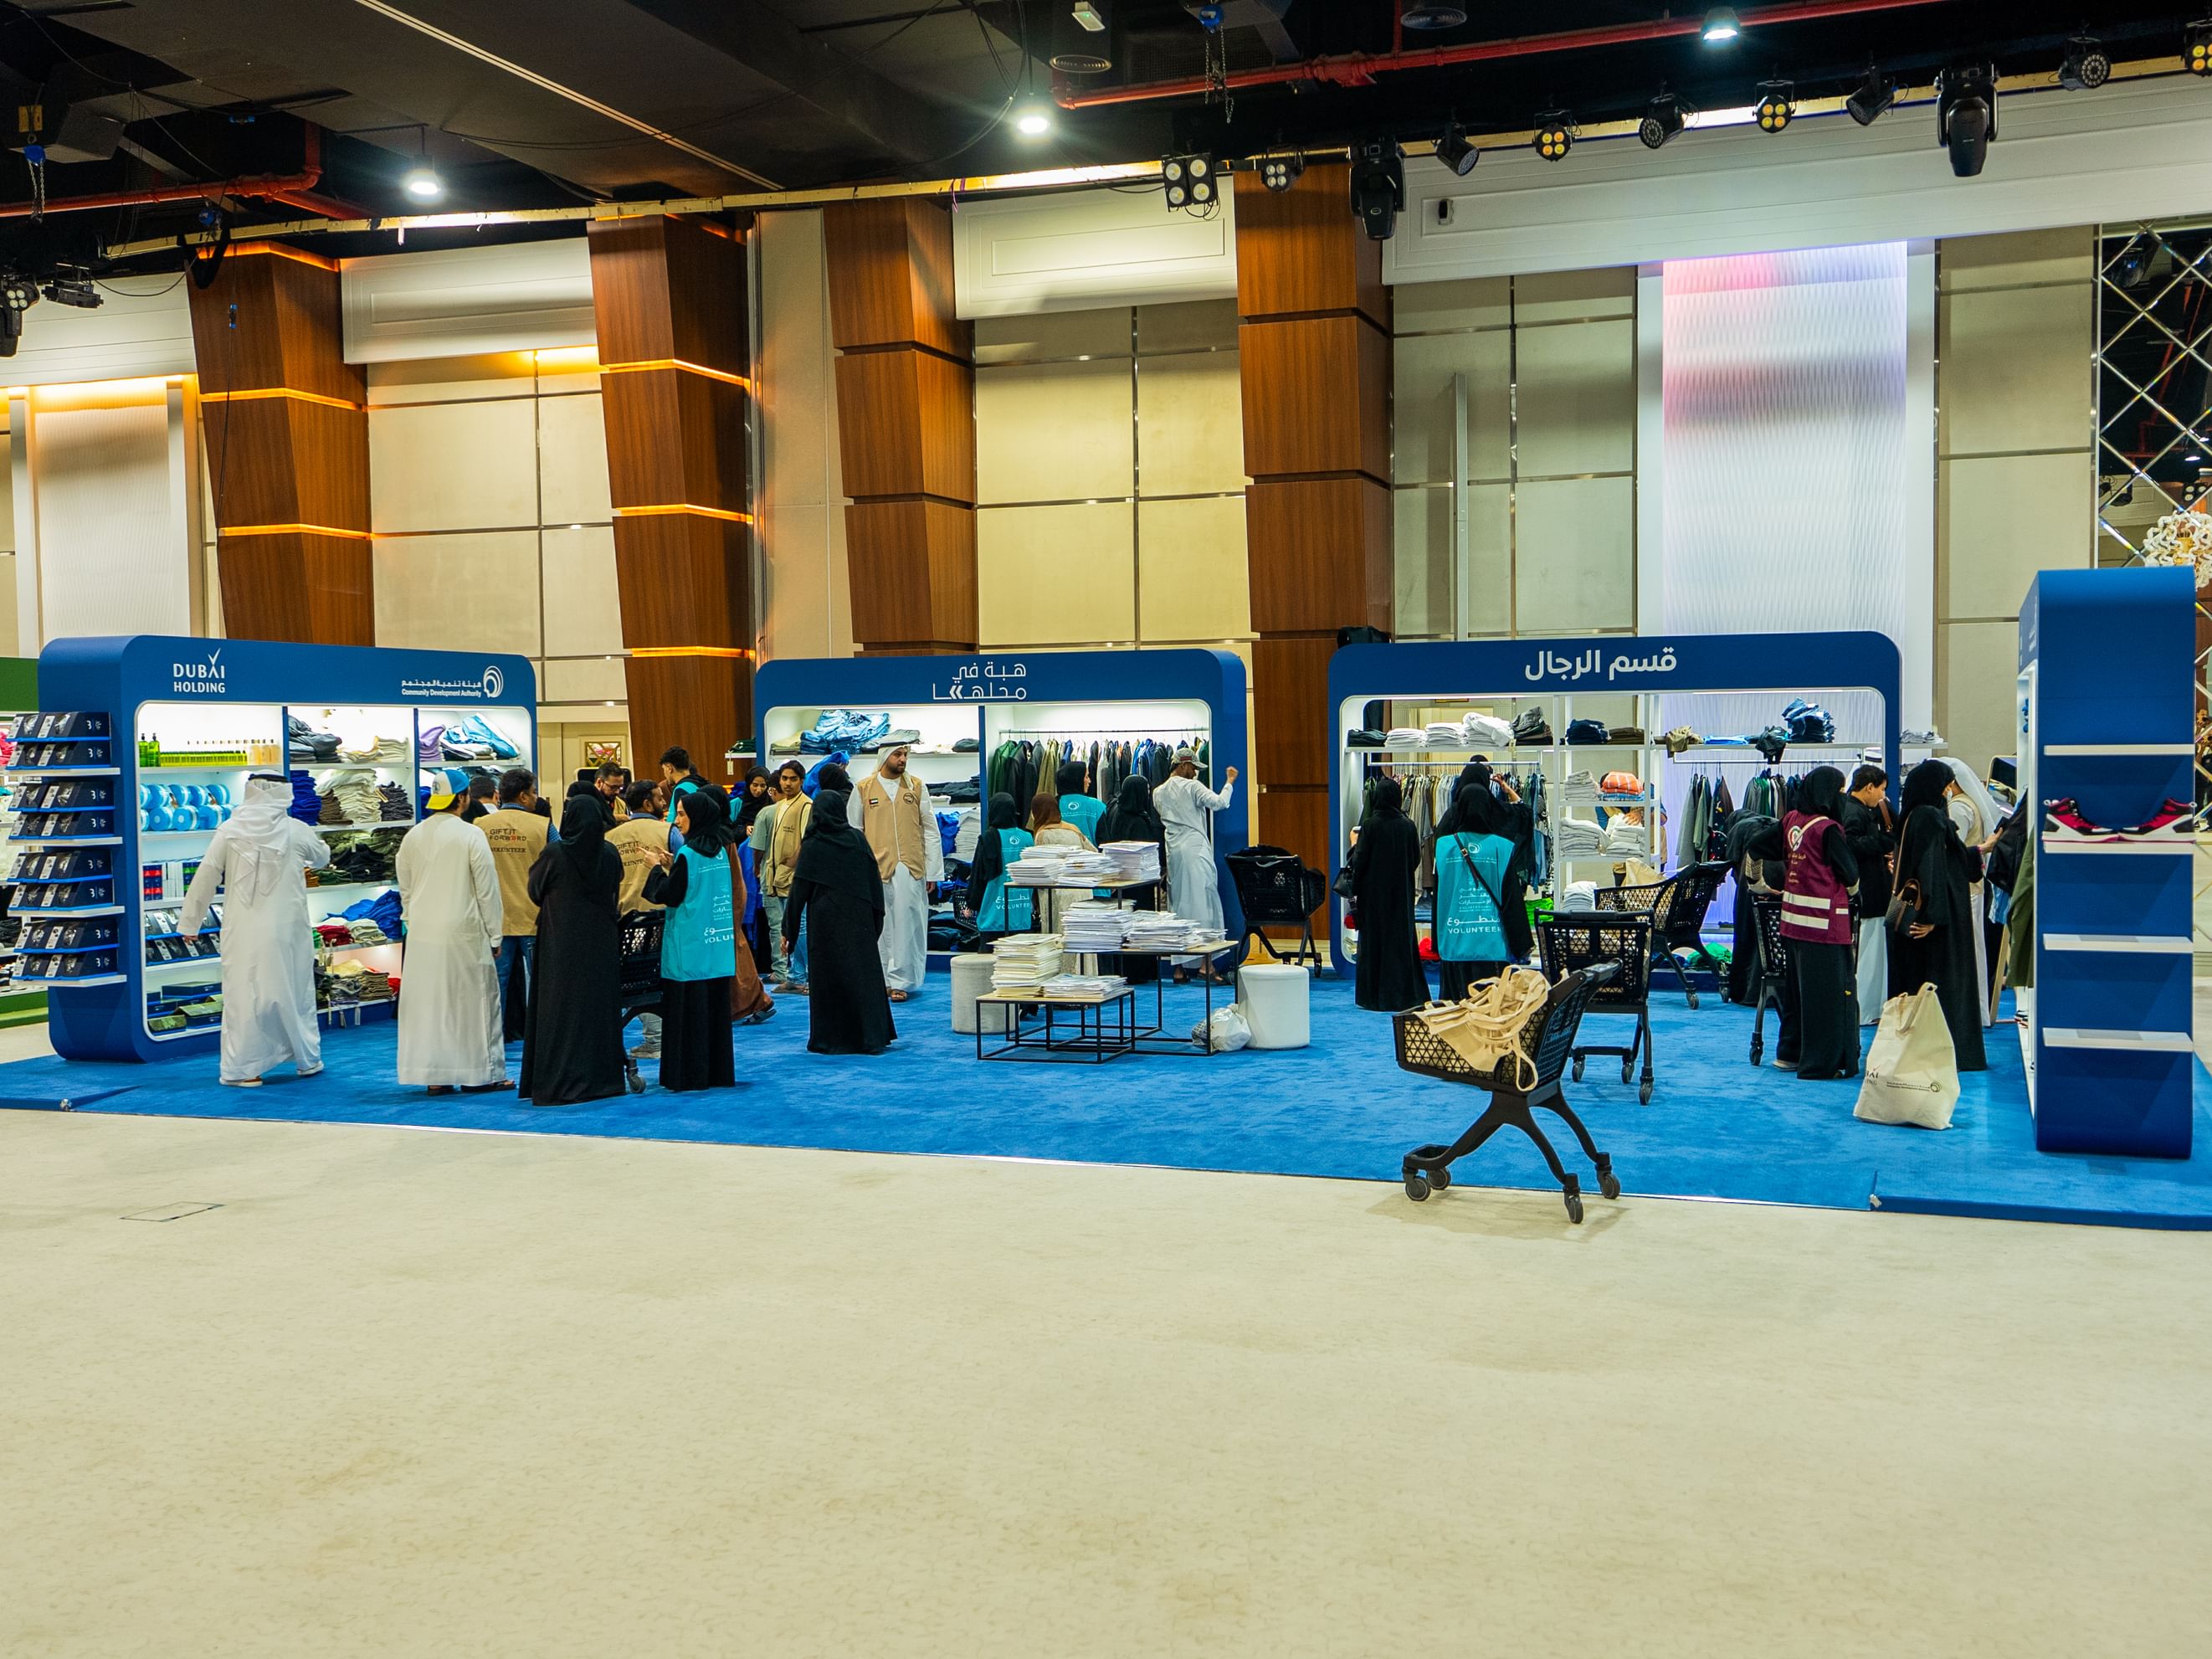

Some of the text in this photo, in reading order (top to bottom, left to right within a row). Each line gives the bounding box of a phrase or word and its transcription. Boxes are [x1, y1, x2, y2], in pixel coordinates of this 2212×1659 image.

[172, 648, 225, 679] DUBAI
[952, 661, 1026, 684] هبة في
[1525, 646, 1677, 681] قسم الرجال
[173, 681, 225, 693] HOLDING
[402, 688, 481, 698] Community Development Authority
